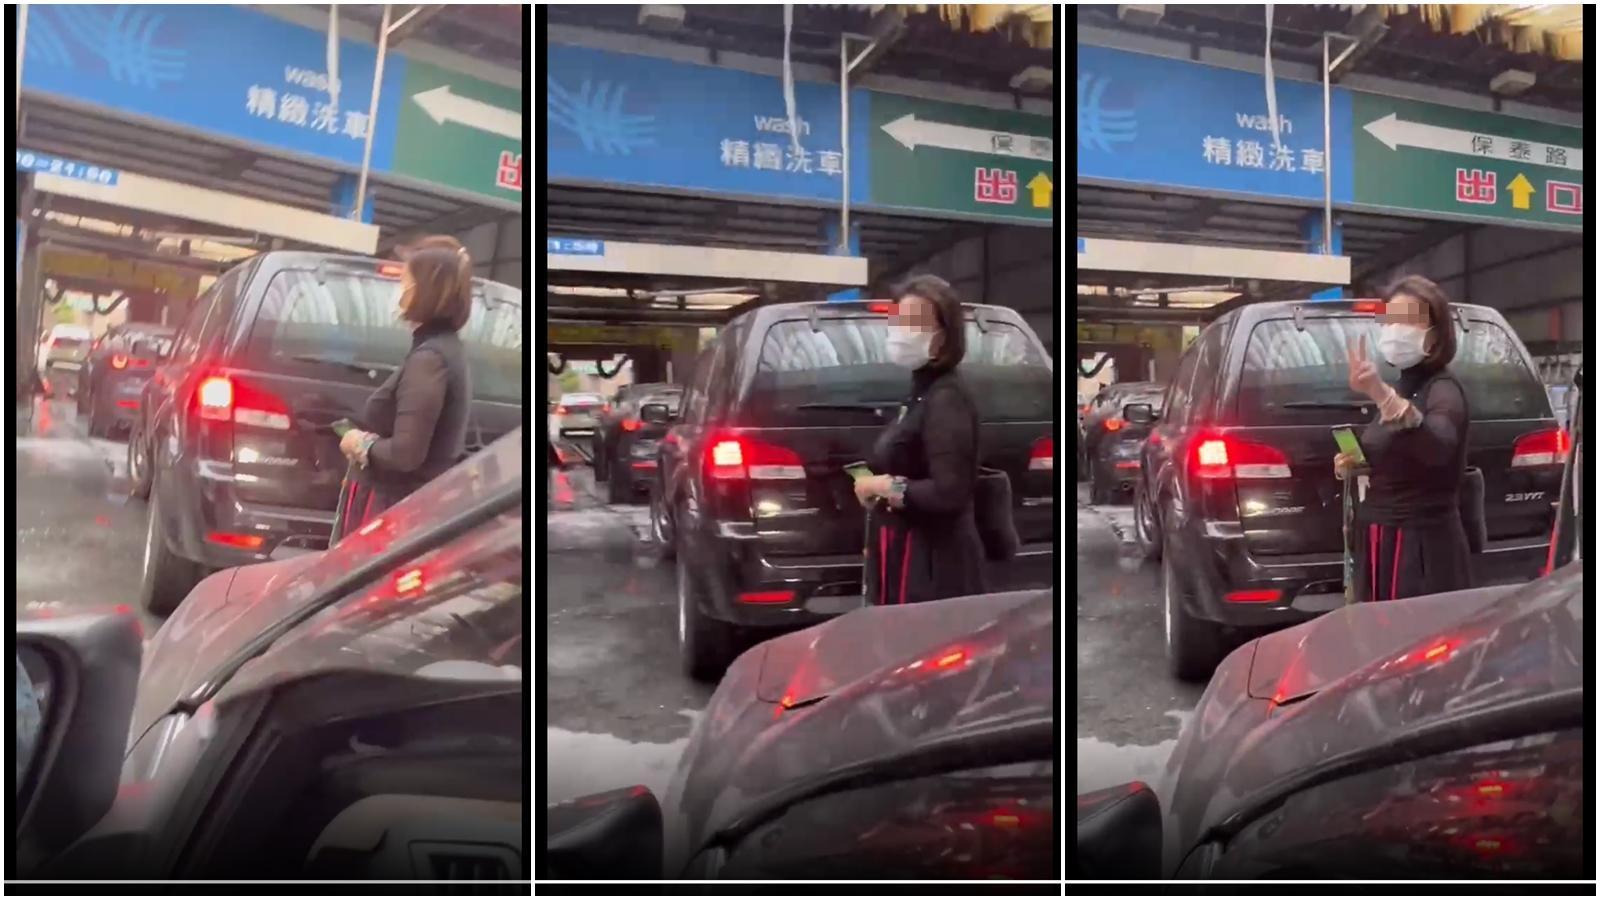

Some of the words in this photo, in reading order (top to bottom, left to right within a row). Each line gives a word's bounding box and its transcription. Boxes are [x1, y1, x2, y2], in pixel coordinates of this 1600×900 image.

[1202, 135, 1325, 174] 精緻洗車
[975, 167, 1017, 204] 出
[1456, 168, 1497, 204] 出
[1546, 180, 1583, 214] 口
